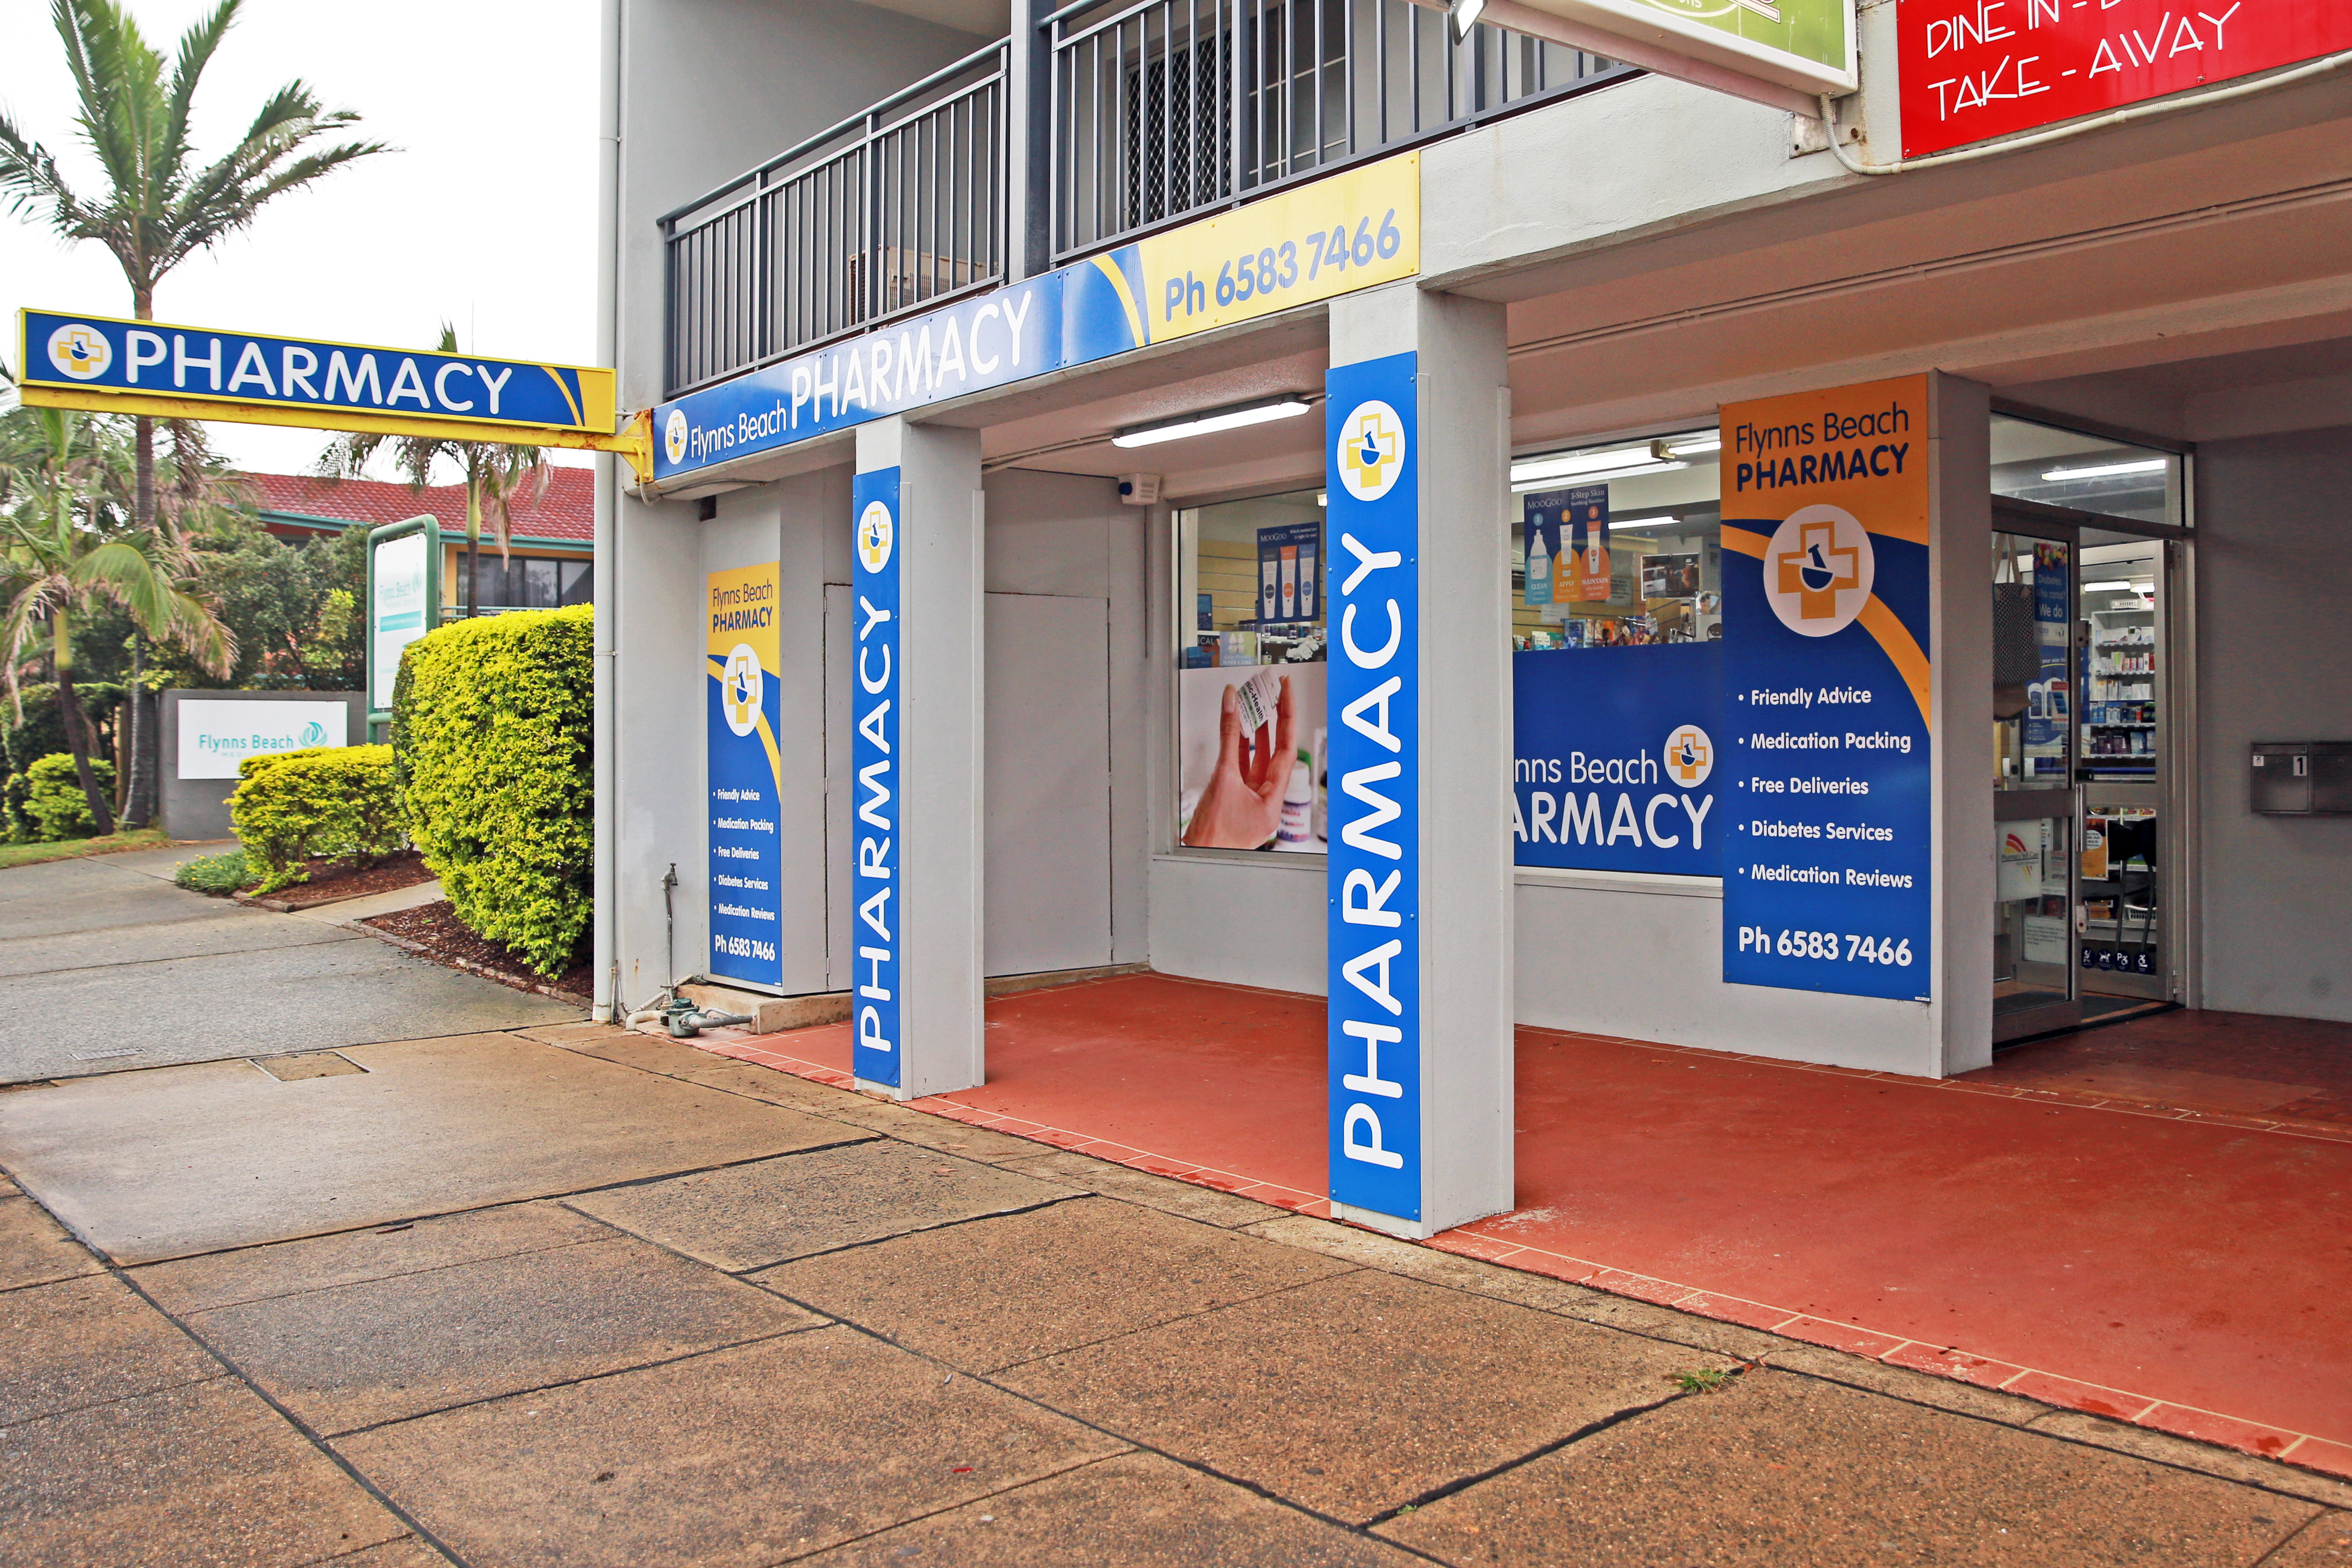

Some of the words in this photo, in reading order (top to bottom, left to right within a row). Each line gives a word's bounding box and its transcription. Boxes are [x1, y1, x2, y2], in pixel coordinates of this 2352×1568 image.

[1927, 0, 2015, 59] DINE
[2028, 0, 2060, 30] IN
[1927, 55, 2050, 122] TAKE
[2088, 1, 2241, 79] AWAY
[1165, 276, 1204, 322] Ph
[1215, 241, 1299, 307] 6583
[1306, 208, 1400, 281] 7466
[126, 329, 512, 415] PHARMACY
[690, 420, 735, 464] Flynns
[738, 399, 787, 443] Beach
[792, 290, 1033, 429] PHARMACY
[1736, 422, 1814, 459] Flynns
[1824, 401, 1909, 442] Beach
[1737, 442, 1909, 492] PHARMACY
[1571, 491, 1589, 499] 3-Step
[1591, 489, 1605, 497] Skin
[1582, 577, 1608, 585] MAINTAIN
[713, 586, 740, 611] Flynns
[743, 578, 772, 602] Beach
[713, 606, 772, 633] PHARMACY
[2039, 604, 2051, 617] We
[2053, 604, 2063, 618] do
[1751, 688, 1813, 709] Friendly
[1817, 686, 1872, 704] Advice
[199, 734, 247, 752] Flynns
[252, 734, 293, 749] Beach
[1751, 732, 1839, 750] Medication
[1845, 731, 1912, 754] Packing
[1571, 748, 1657, 785] Beach
[2297, 757, 2303, 774] 1
[717, 789, 739, 803] Friendly
[740, 789, 760, 802] Advice
[1751, 776, 1784, 794] Free
[1790, 776, 1869, 795] Deliveries
[718, 817, 749, 830] Medication
[750, 819, 774, 834] Packing
[859, 595, 891, 1052] PHARMACY
[1751, 820, 1821, 839] Diabetes
[1826, 822, 1893, 842] Services
[718, 846, 730, 858] Free
[731, 846, 759, 860] Deliveries
[1340, 532, 1404, 1170] PHARMACY
[718, 874, 743, 888] Diabetes
[744, 876, 768, 891] Services
[1751, 864, 1840, 885] Medication
[1846, 868, 1913, 888] Reviews
[718, 903, 750, 918] Medication
[751, 907, 775, 922] Reviews
[715, 934, 727, 953] Ph
[728, 936, 750, 958] 6583
[751, 940, 775, 962] 7466
[1739, 926, 1770, 954] Ph
[1776, 929, 1840, 960] 6583
[1845, 935, 1913, 967] 7466
